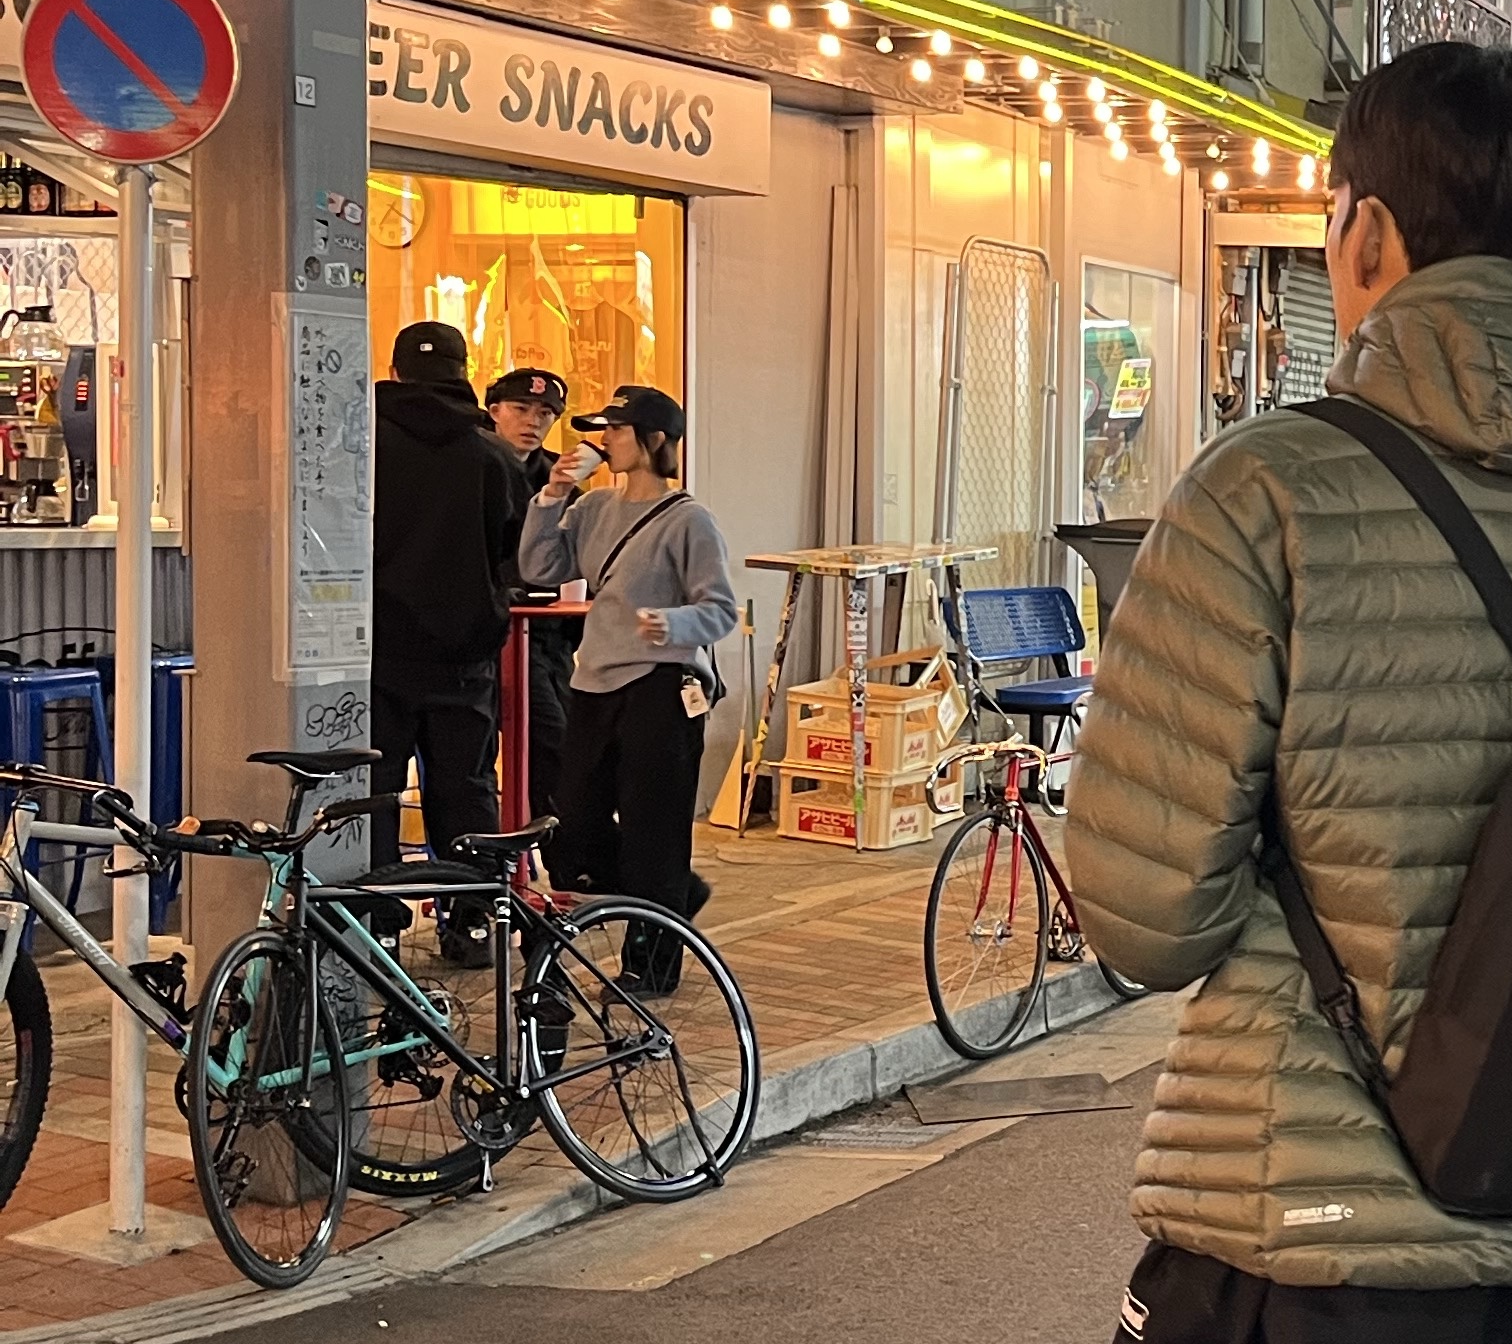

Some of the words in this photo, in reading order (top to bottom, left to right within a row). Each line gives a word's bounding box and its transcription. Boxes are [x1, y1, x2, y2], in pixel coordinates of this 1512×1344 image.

[298, 82, 314, 100] 12
[499, 53, 715, 158] SNACKS
[360, 1165, 439, 1183] MAXXIS
